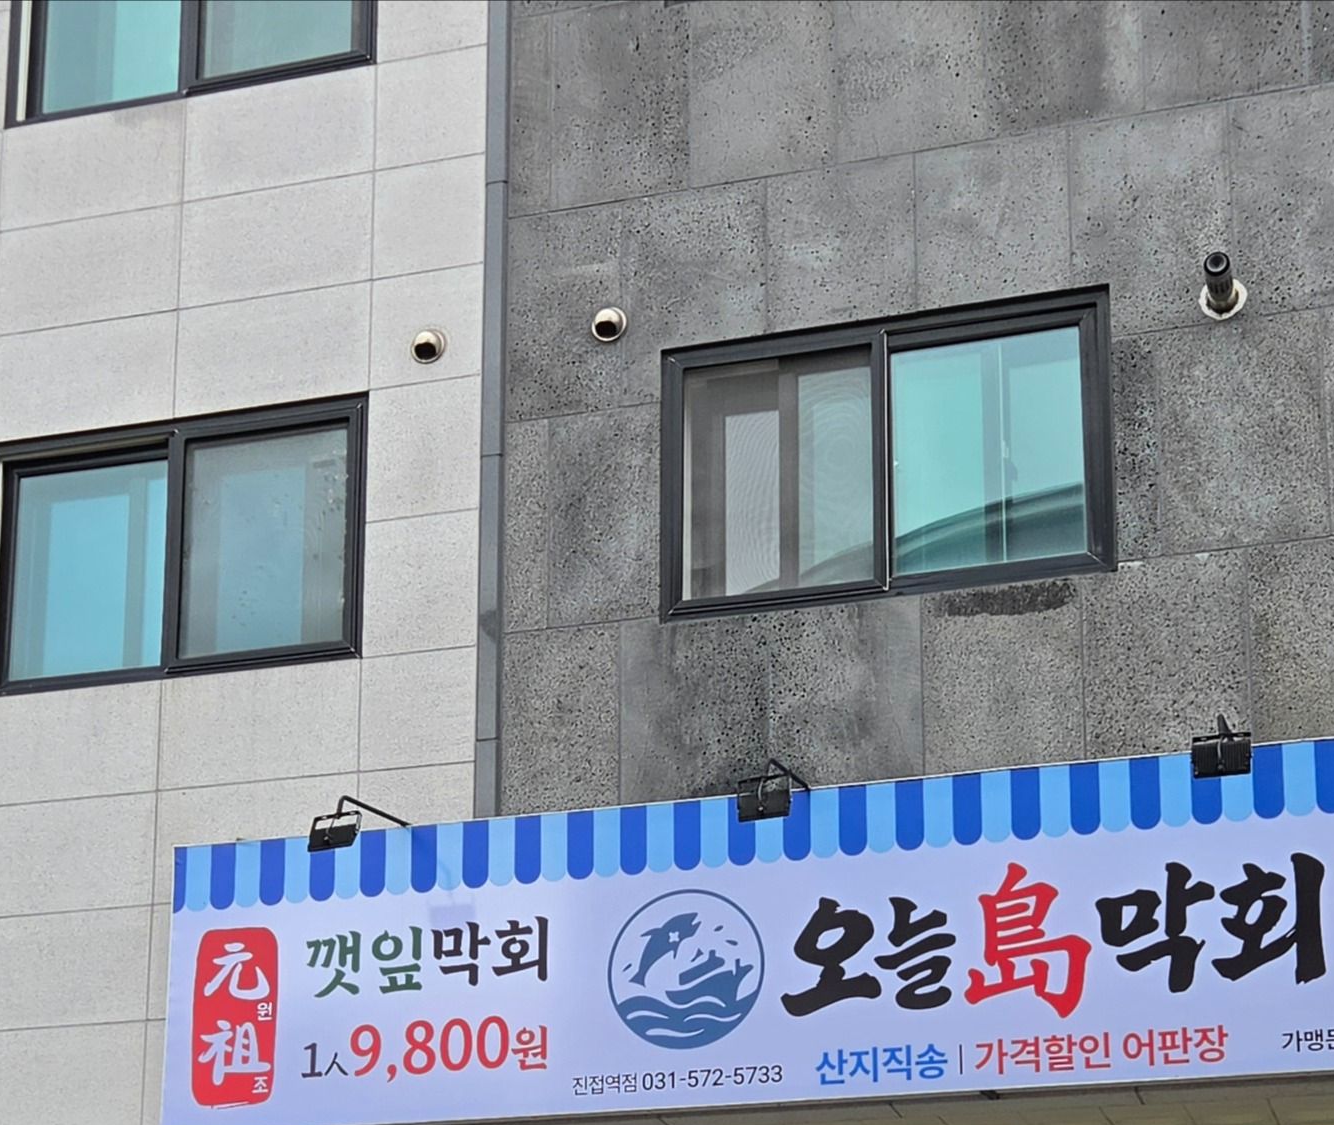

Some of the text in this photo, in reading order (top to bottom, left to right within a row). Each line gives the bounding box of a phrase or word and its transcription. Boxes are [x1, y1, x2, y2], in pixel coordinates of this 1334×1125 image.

[305, 916, 549, 998] 깻잎막회
[572, 1064, 783, 1096] 진접역점 031-572-5733
[815, 1025, 1228, 1085] 산지직송 가격할인 어판장
